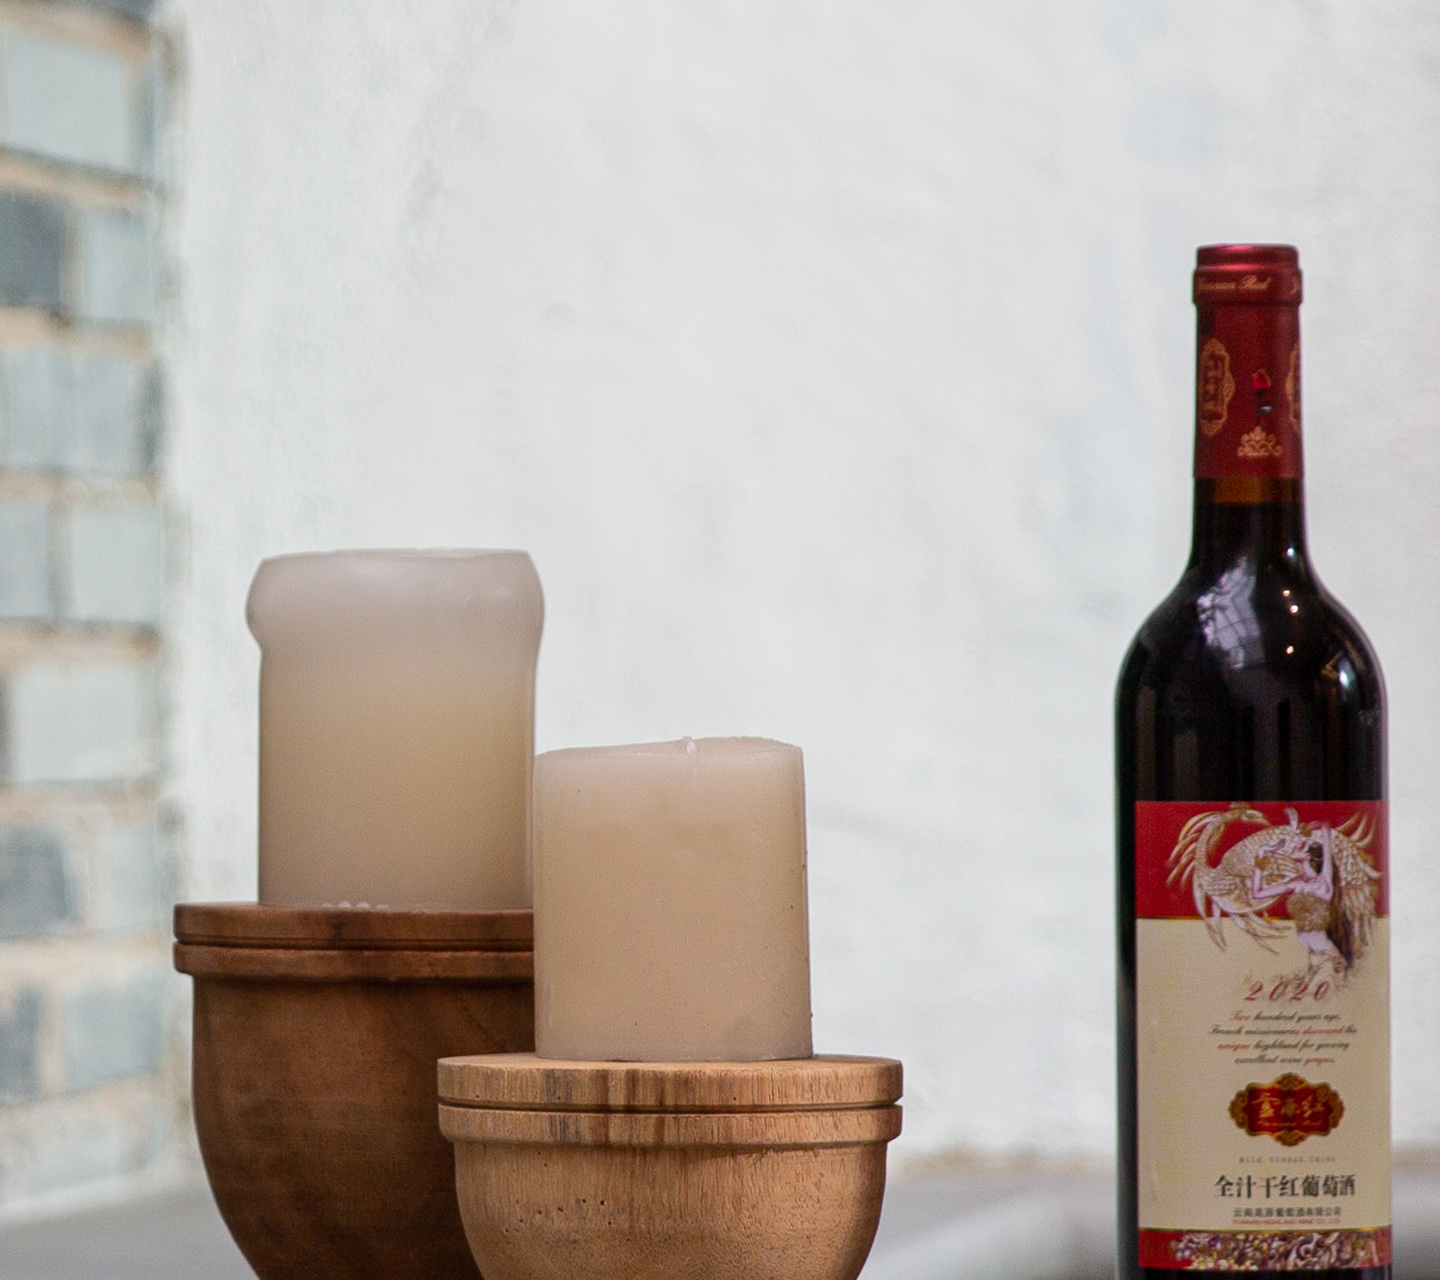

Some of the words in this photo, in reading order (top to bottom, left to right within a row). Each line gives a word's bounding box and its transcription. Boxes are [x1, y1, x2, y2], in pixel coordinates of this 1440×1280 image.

[1244, 980, 1330, 1002] 2020
[1214, 1173, 1356, 1199] 全汁干红葡萄酒
